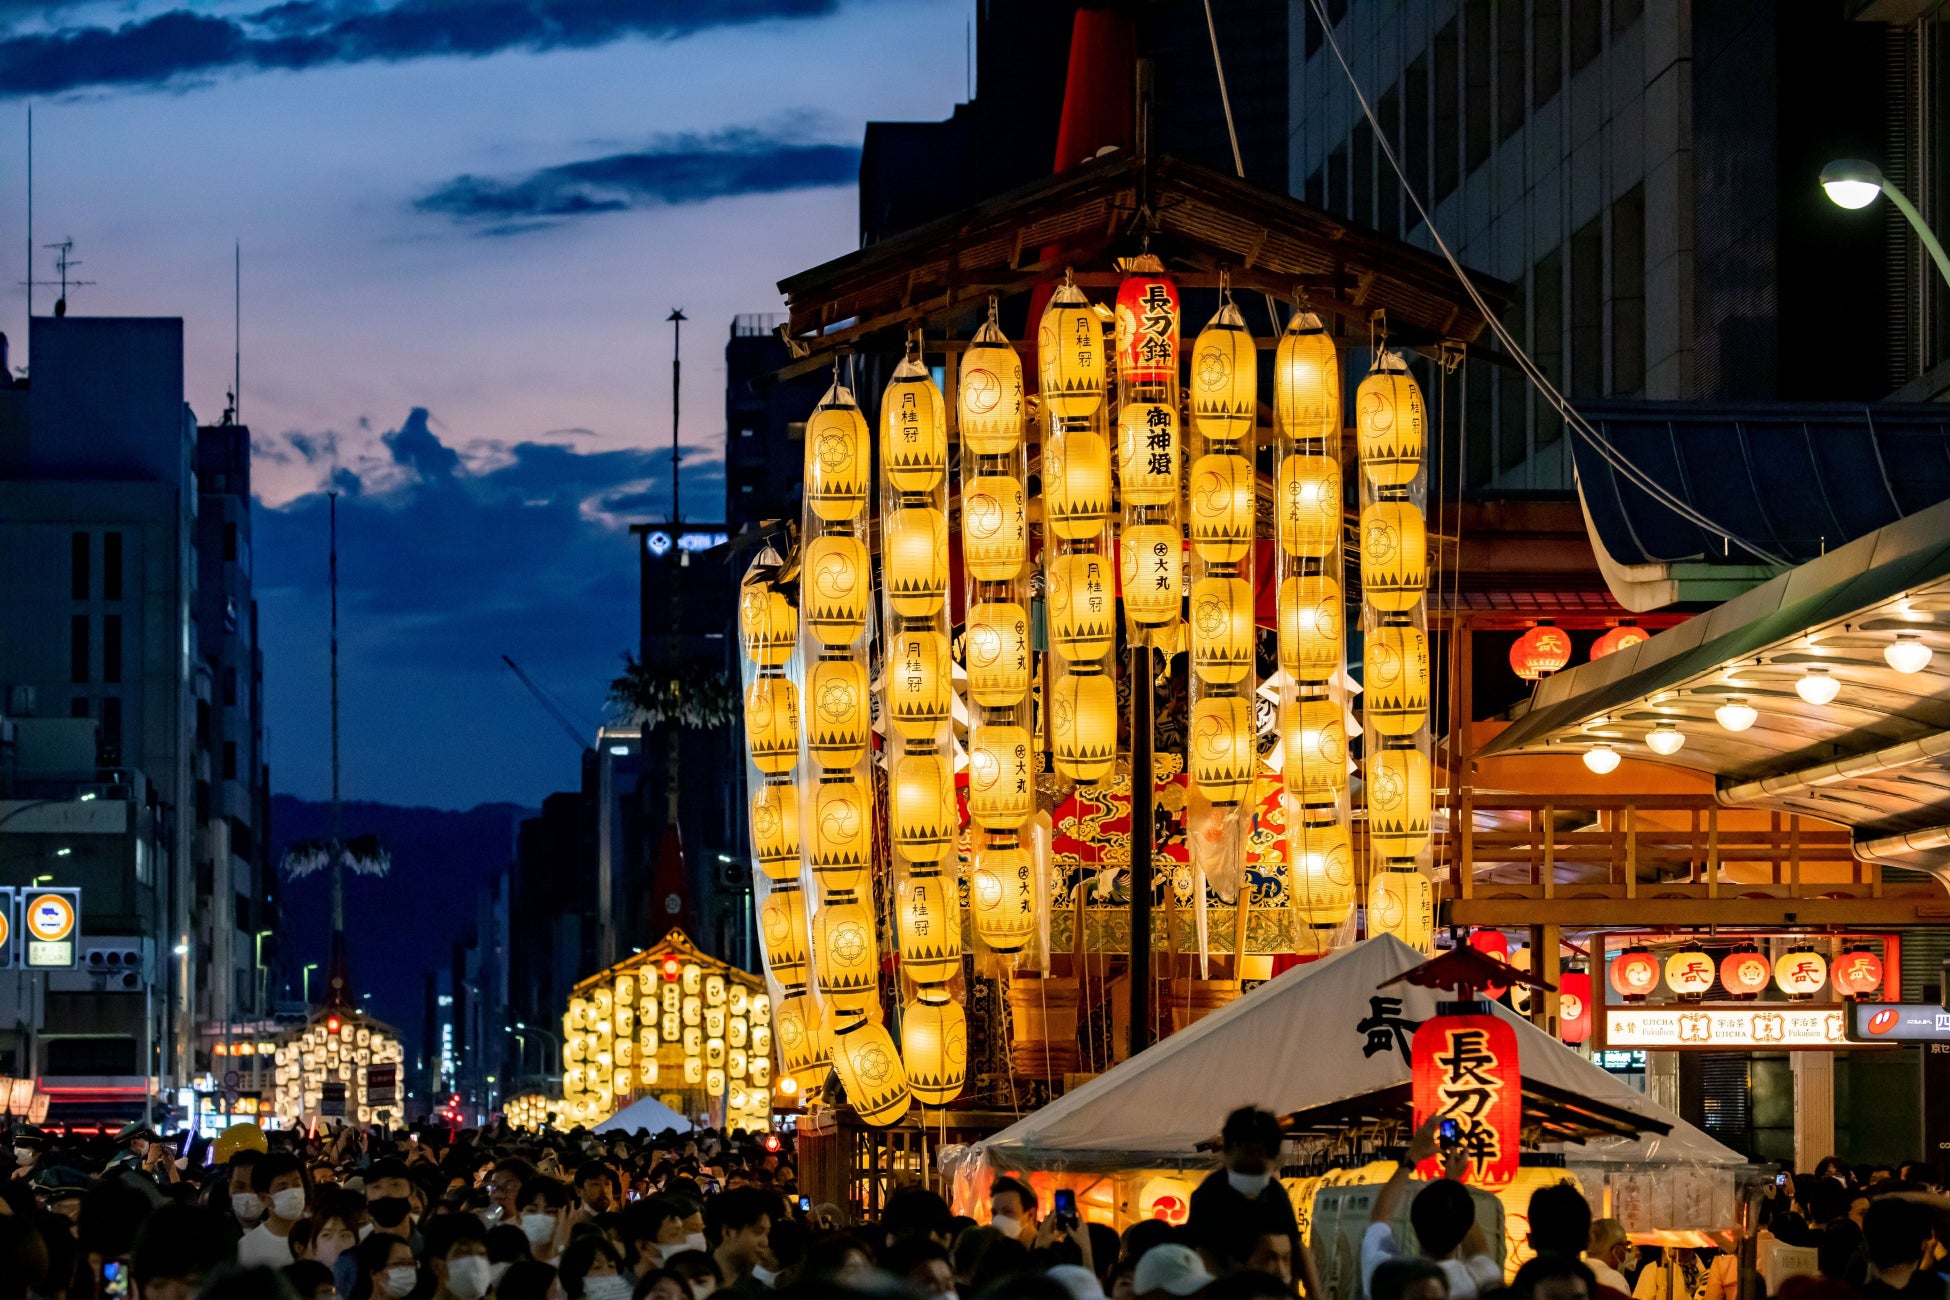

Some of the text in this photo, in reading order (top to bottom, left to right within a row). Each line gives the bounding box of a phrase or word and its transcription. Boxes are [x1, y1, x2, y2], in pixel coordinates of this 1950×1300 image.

[1075, 317, 1093, 368] 月桂冠
[1140, 285, 1173, 366] 長刀鉾
[901, 392, 919, 443] 月桂冠
[1146, 406, 1172, 476] 御神燈
[1087, 562, 1103, 613] 月桂冠
[1154, 558, 1171, 591] 大丸
[905, 642, 922, 693] 月桂冠
[911, 885, 929, 937] 月桂冠
[1642, 1018, 1674, 1027] UJICHA
